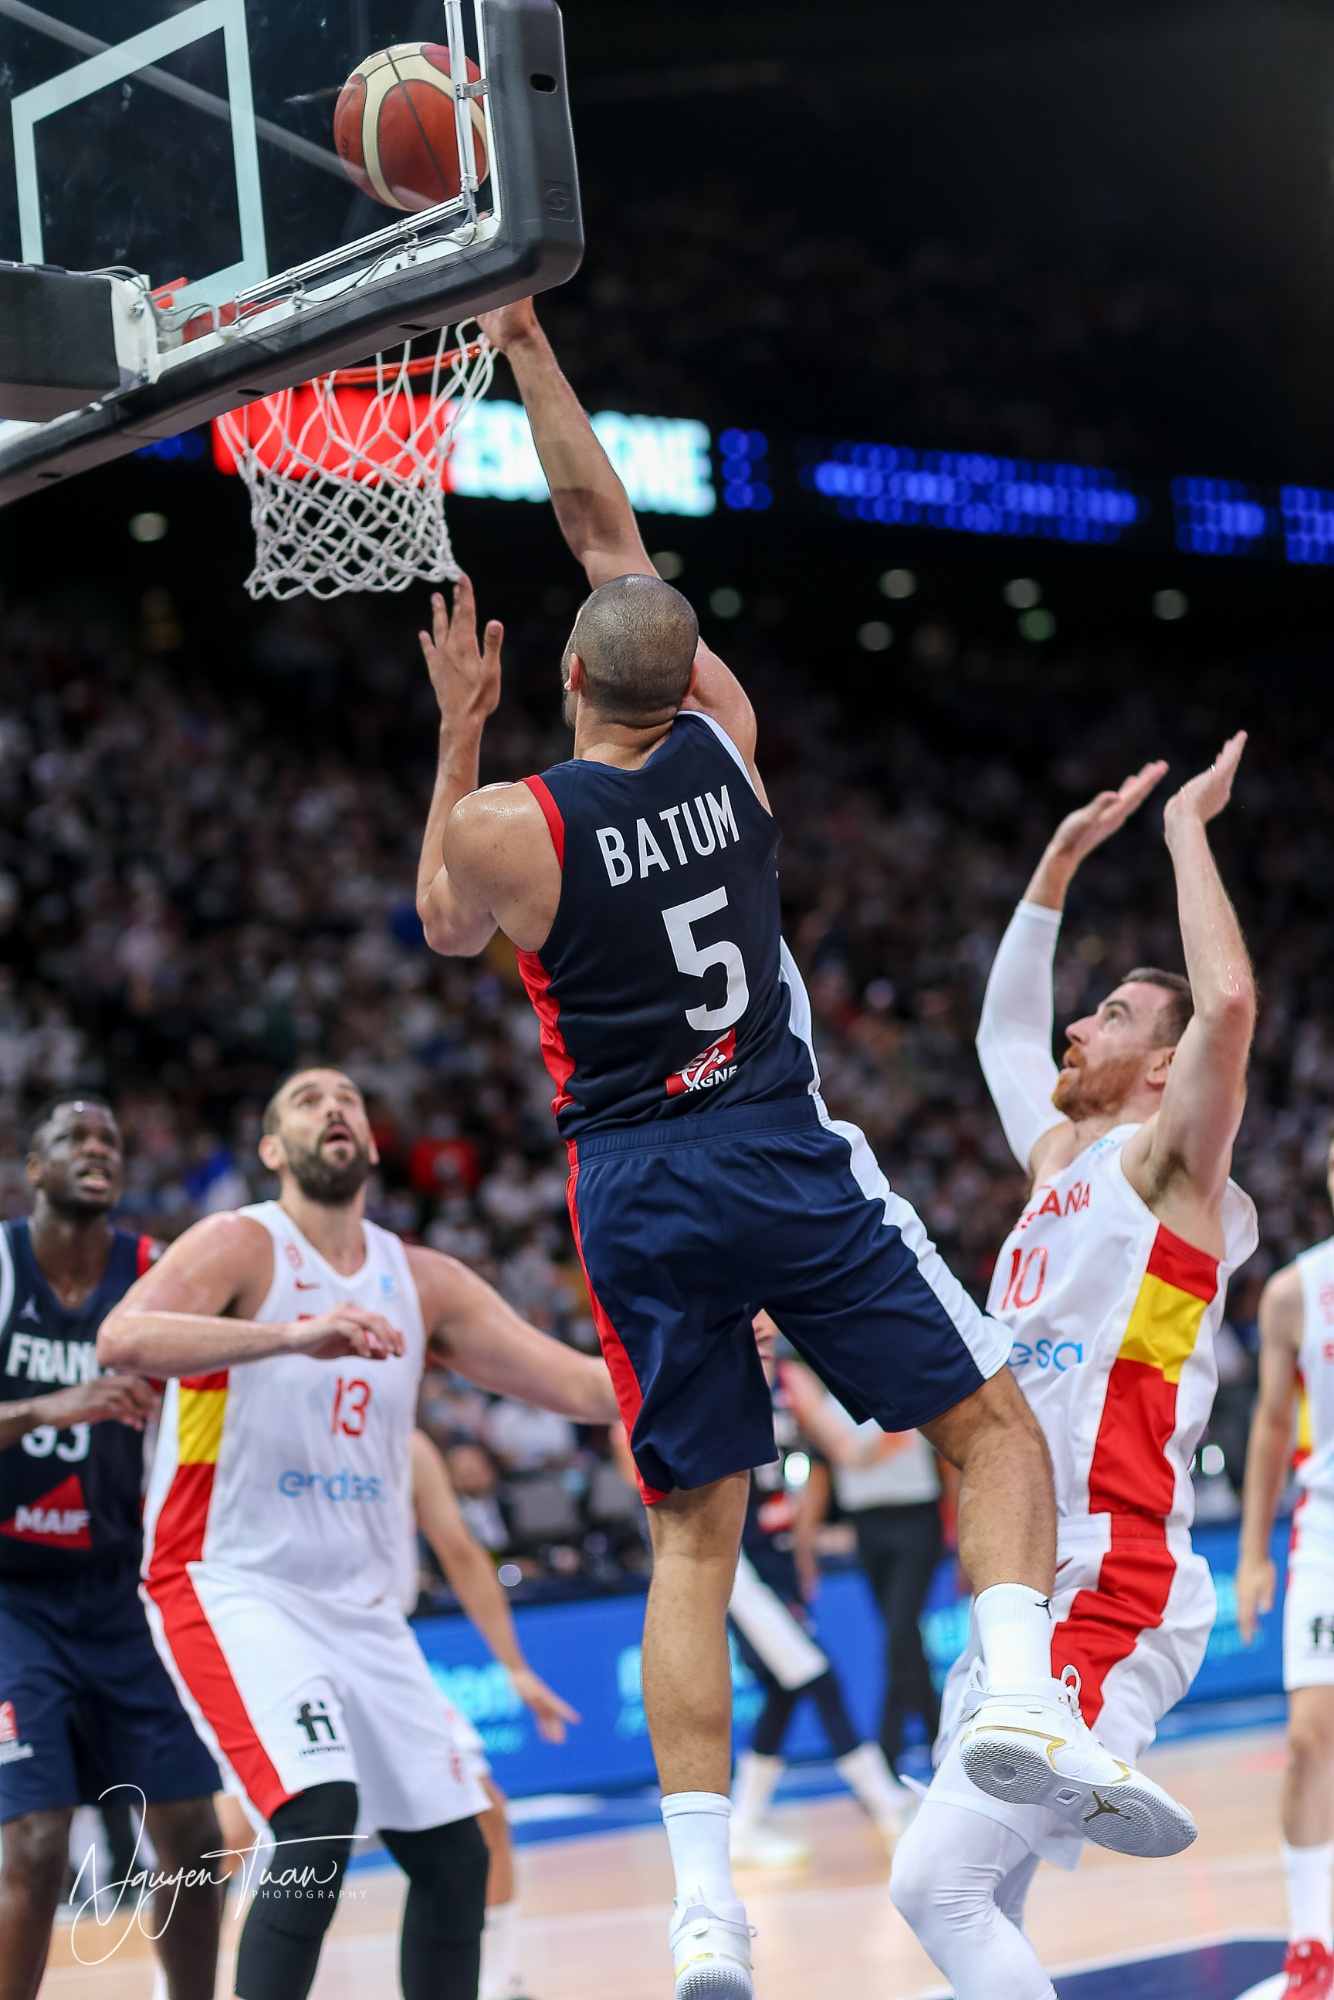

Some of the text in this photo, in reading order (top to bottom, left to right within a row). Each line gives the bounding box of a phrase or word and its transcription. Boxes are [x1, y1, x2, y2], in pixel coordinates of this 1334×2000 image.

[596, 785, 740, 887] BATUM
[661, 886, 749, 1031] 5
[1002, 1247, 1048, 1311] 10
[5, 1332, 112, 1385] FRAN
[332, 1376, 372, 1437] 13
[14, 1505, 91, 1535] MAIF
